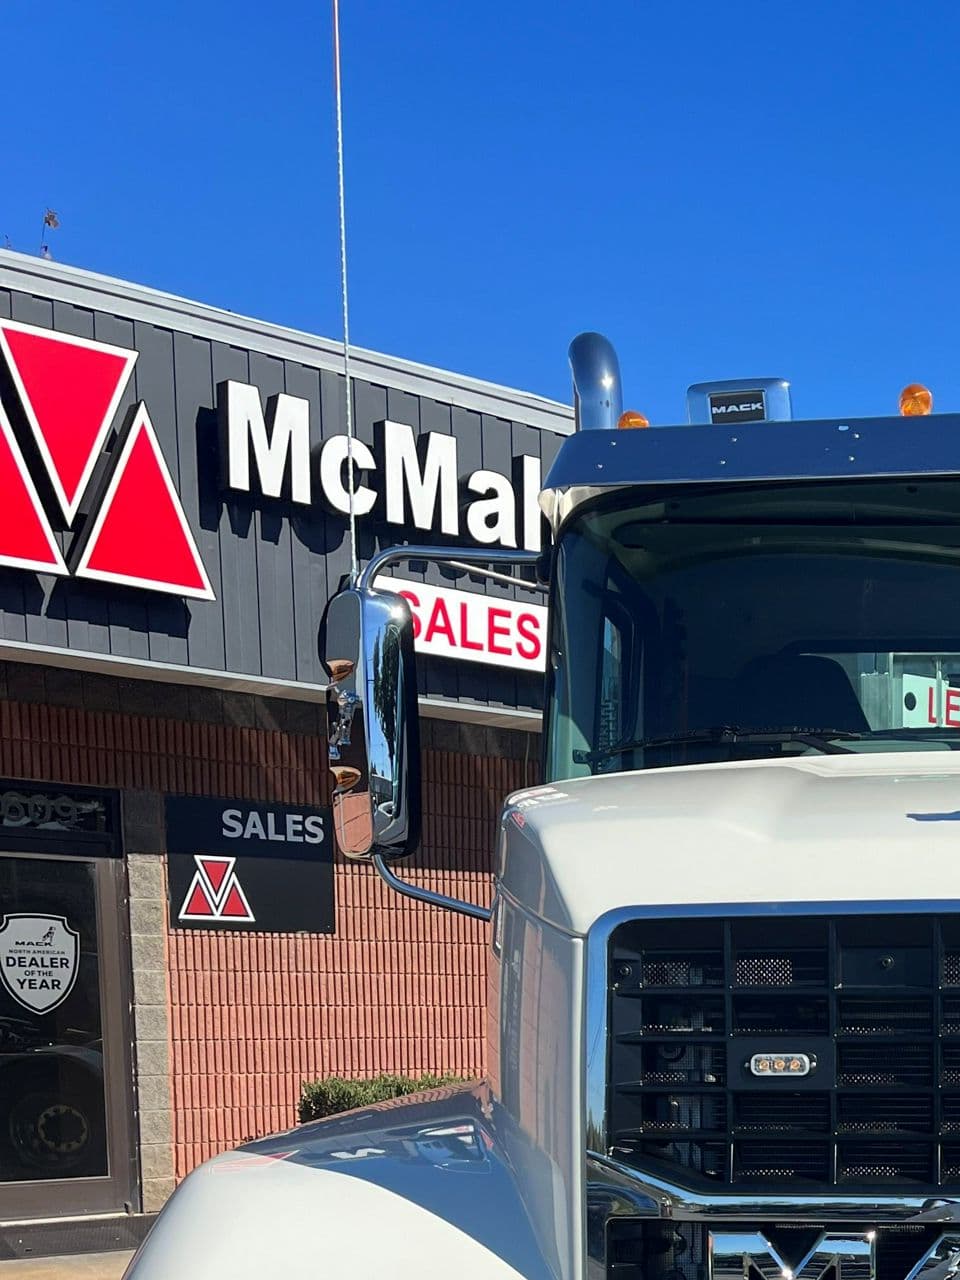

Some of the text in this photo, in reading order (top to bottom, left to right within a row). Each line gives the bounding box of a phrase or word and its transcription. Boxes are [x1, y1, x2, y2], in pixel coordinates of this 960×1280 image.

[711, 402, 764, 414] MACK
[221, 809, 325, 844] SALES
[5, 956, 70, 968] DEALER
[16, 978, 62, 990] YEAR
